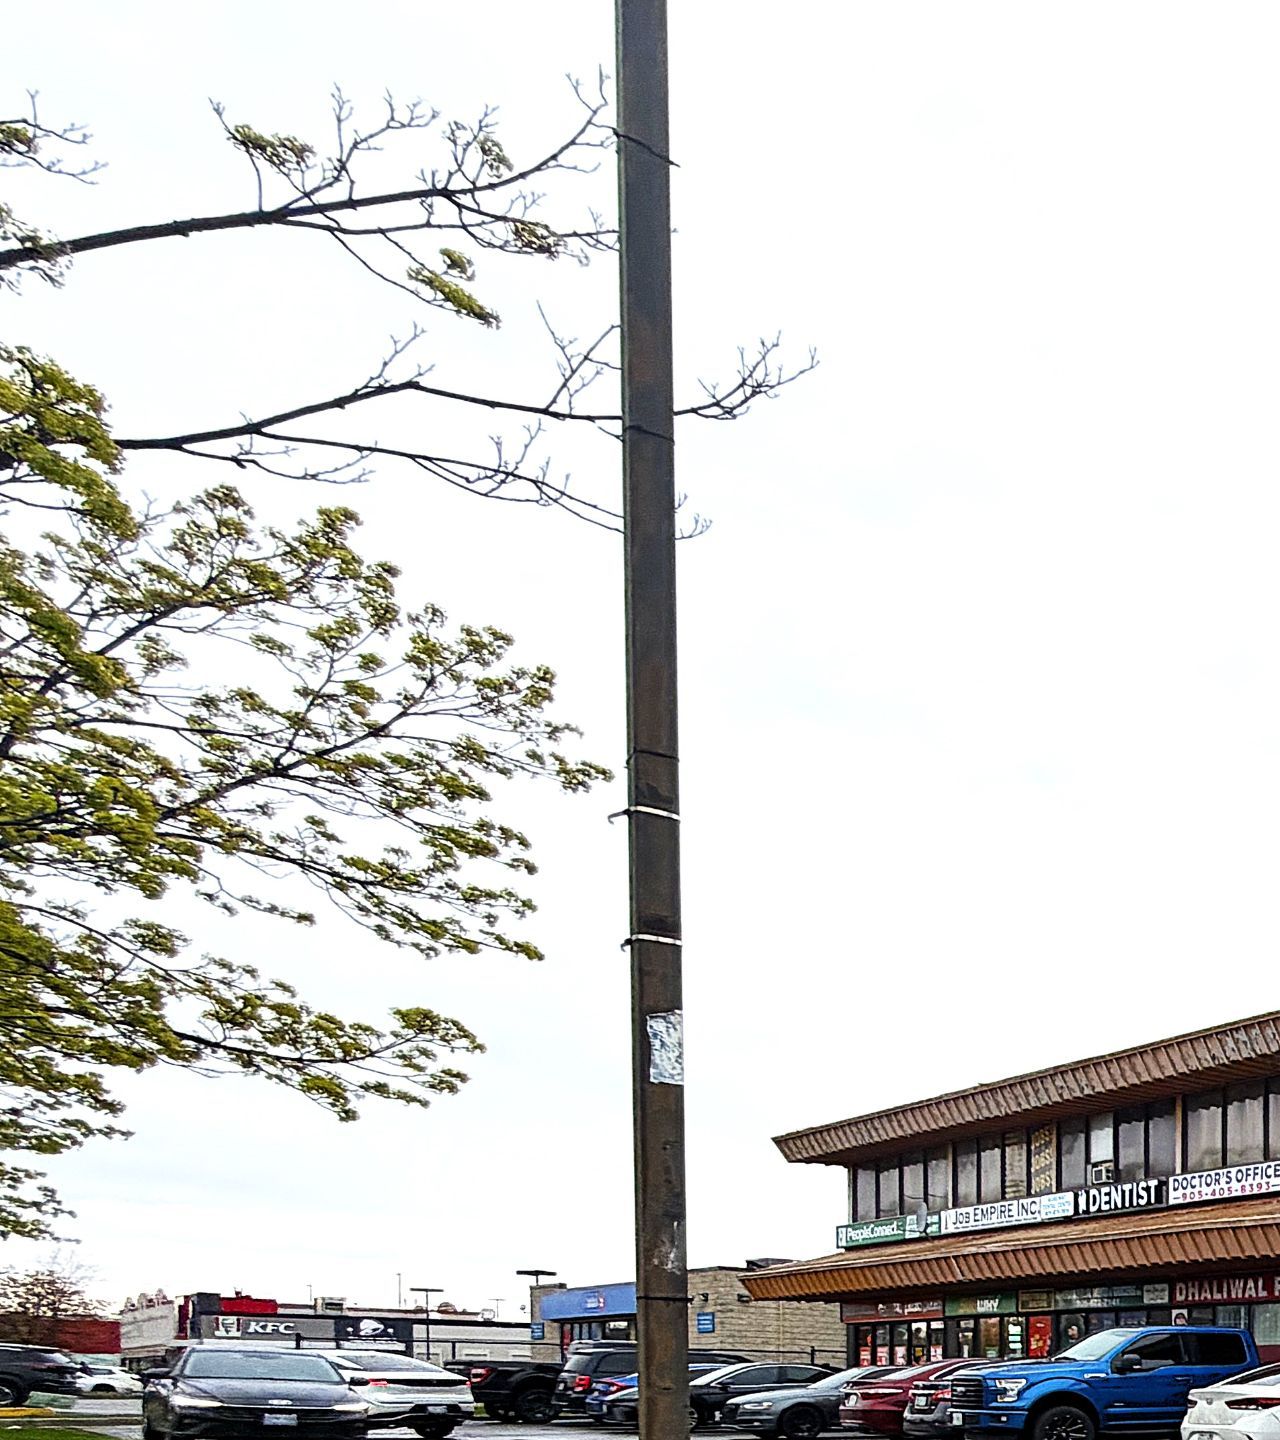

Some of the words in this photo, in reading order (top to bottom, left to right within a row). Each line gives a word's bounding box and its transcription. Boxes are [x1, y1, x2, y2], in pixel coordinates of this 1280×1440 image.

[1173, 1170, 1232, 1191] DOCTOR'S
[1235, 1163, 1280, 1183] OFFICE
[1089, 1179, 1158, 1213] DENTIST
[1182, 1181, 1271, 1201] 905-405-8393
[973, 1204, 1014, 1222] EMPIRE
[1175, 1276, 1268, 1302] DHALIWAL
[247, 1322, 295, 1334] KFC
